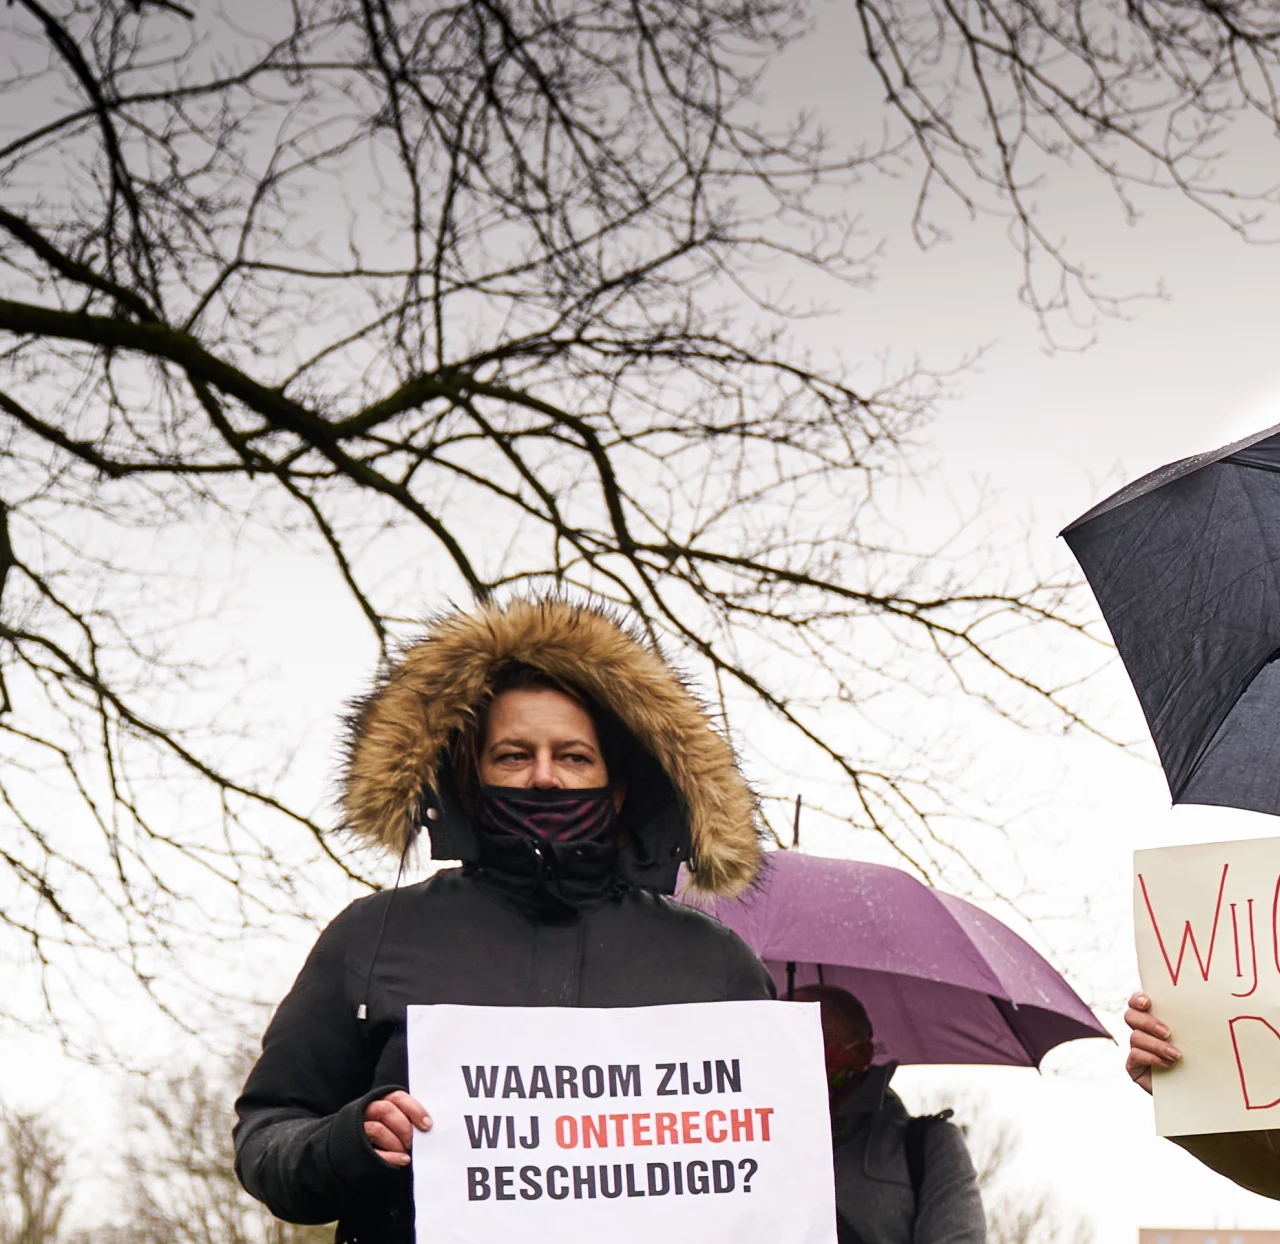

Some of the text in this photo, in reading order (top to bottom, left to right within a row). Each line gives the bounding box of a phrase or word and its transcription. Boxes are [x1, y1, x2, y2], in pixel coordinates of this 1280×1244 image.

[461, 1059, 742, 1099] WAAROM ZIJN
[464, 1107, 774, 1149] WIJ ONTERECHT
[467, 1158, 758, 1201] BESCHULDIGD?
